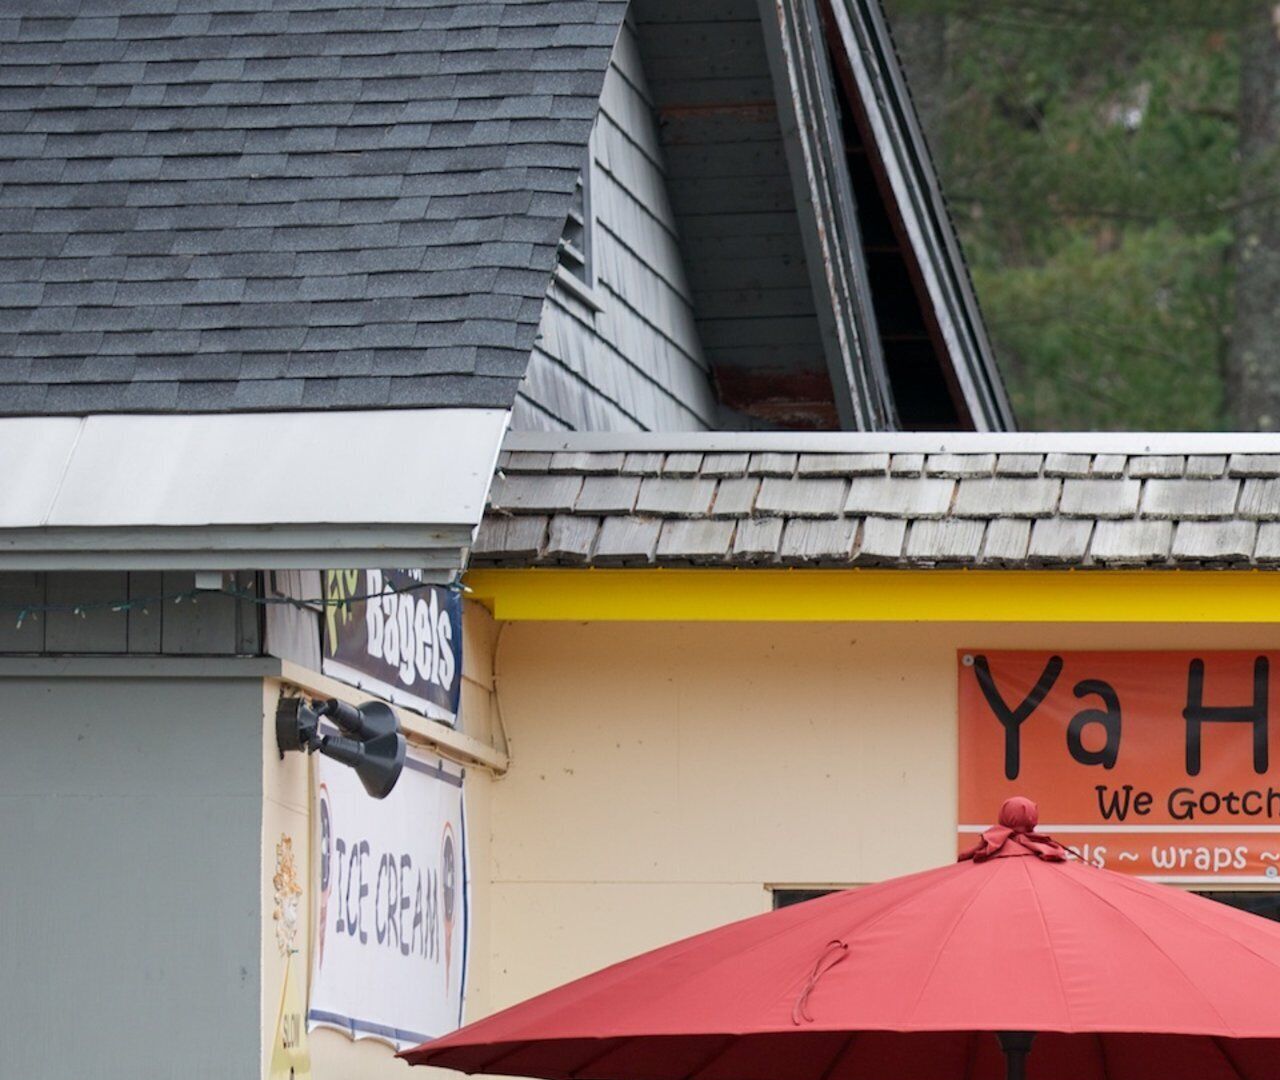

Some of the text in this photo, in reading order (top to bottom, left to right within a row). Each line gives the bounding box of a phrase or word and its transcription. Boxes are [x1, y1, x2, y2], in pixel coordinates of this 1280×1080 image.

[366, 569, 455, 691] Bagels
[973, 655, 1122, 780] Ya
[1096, 785, 1153, 821] We
[1151, 846, 1247, 872] wraps
[336, 838, 440, 964] ICE CREAM
